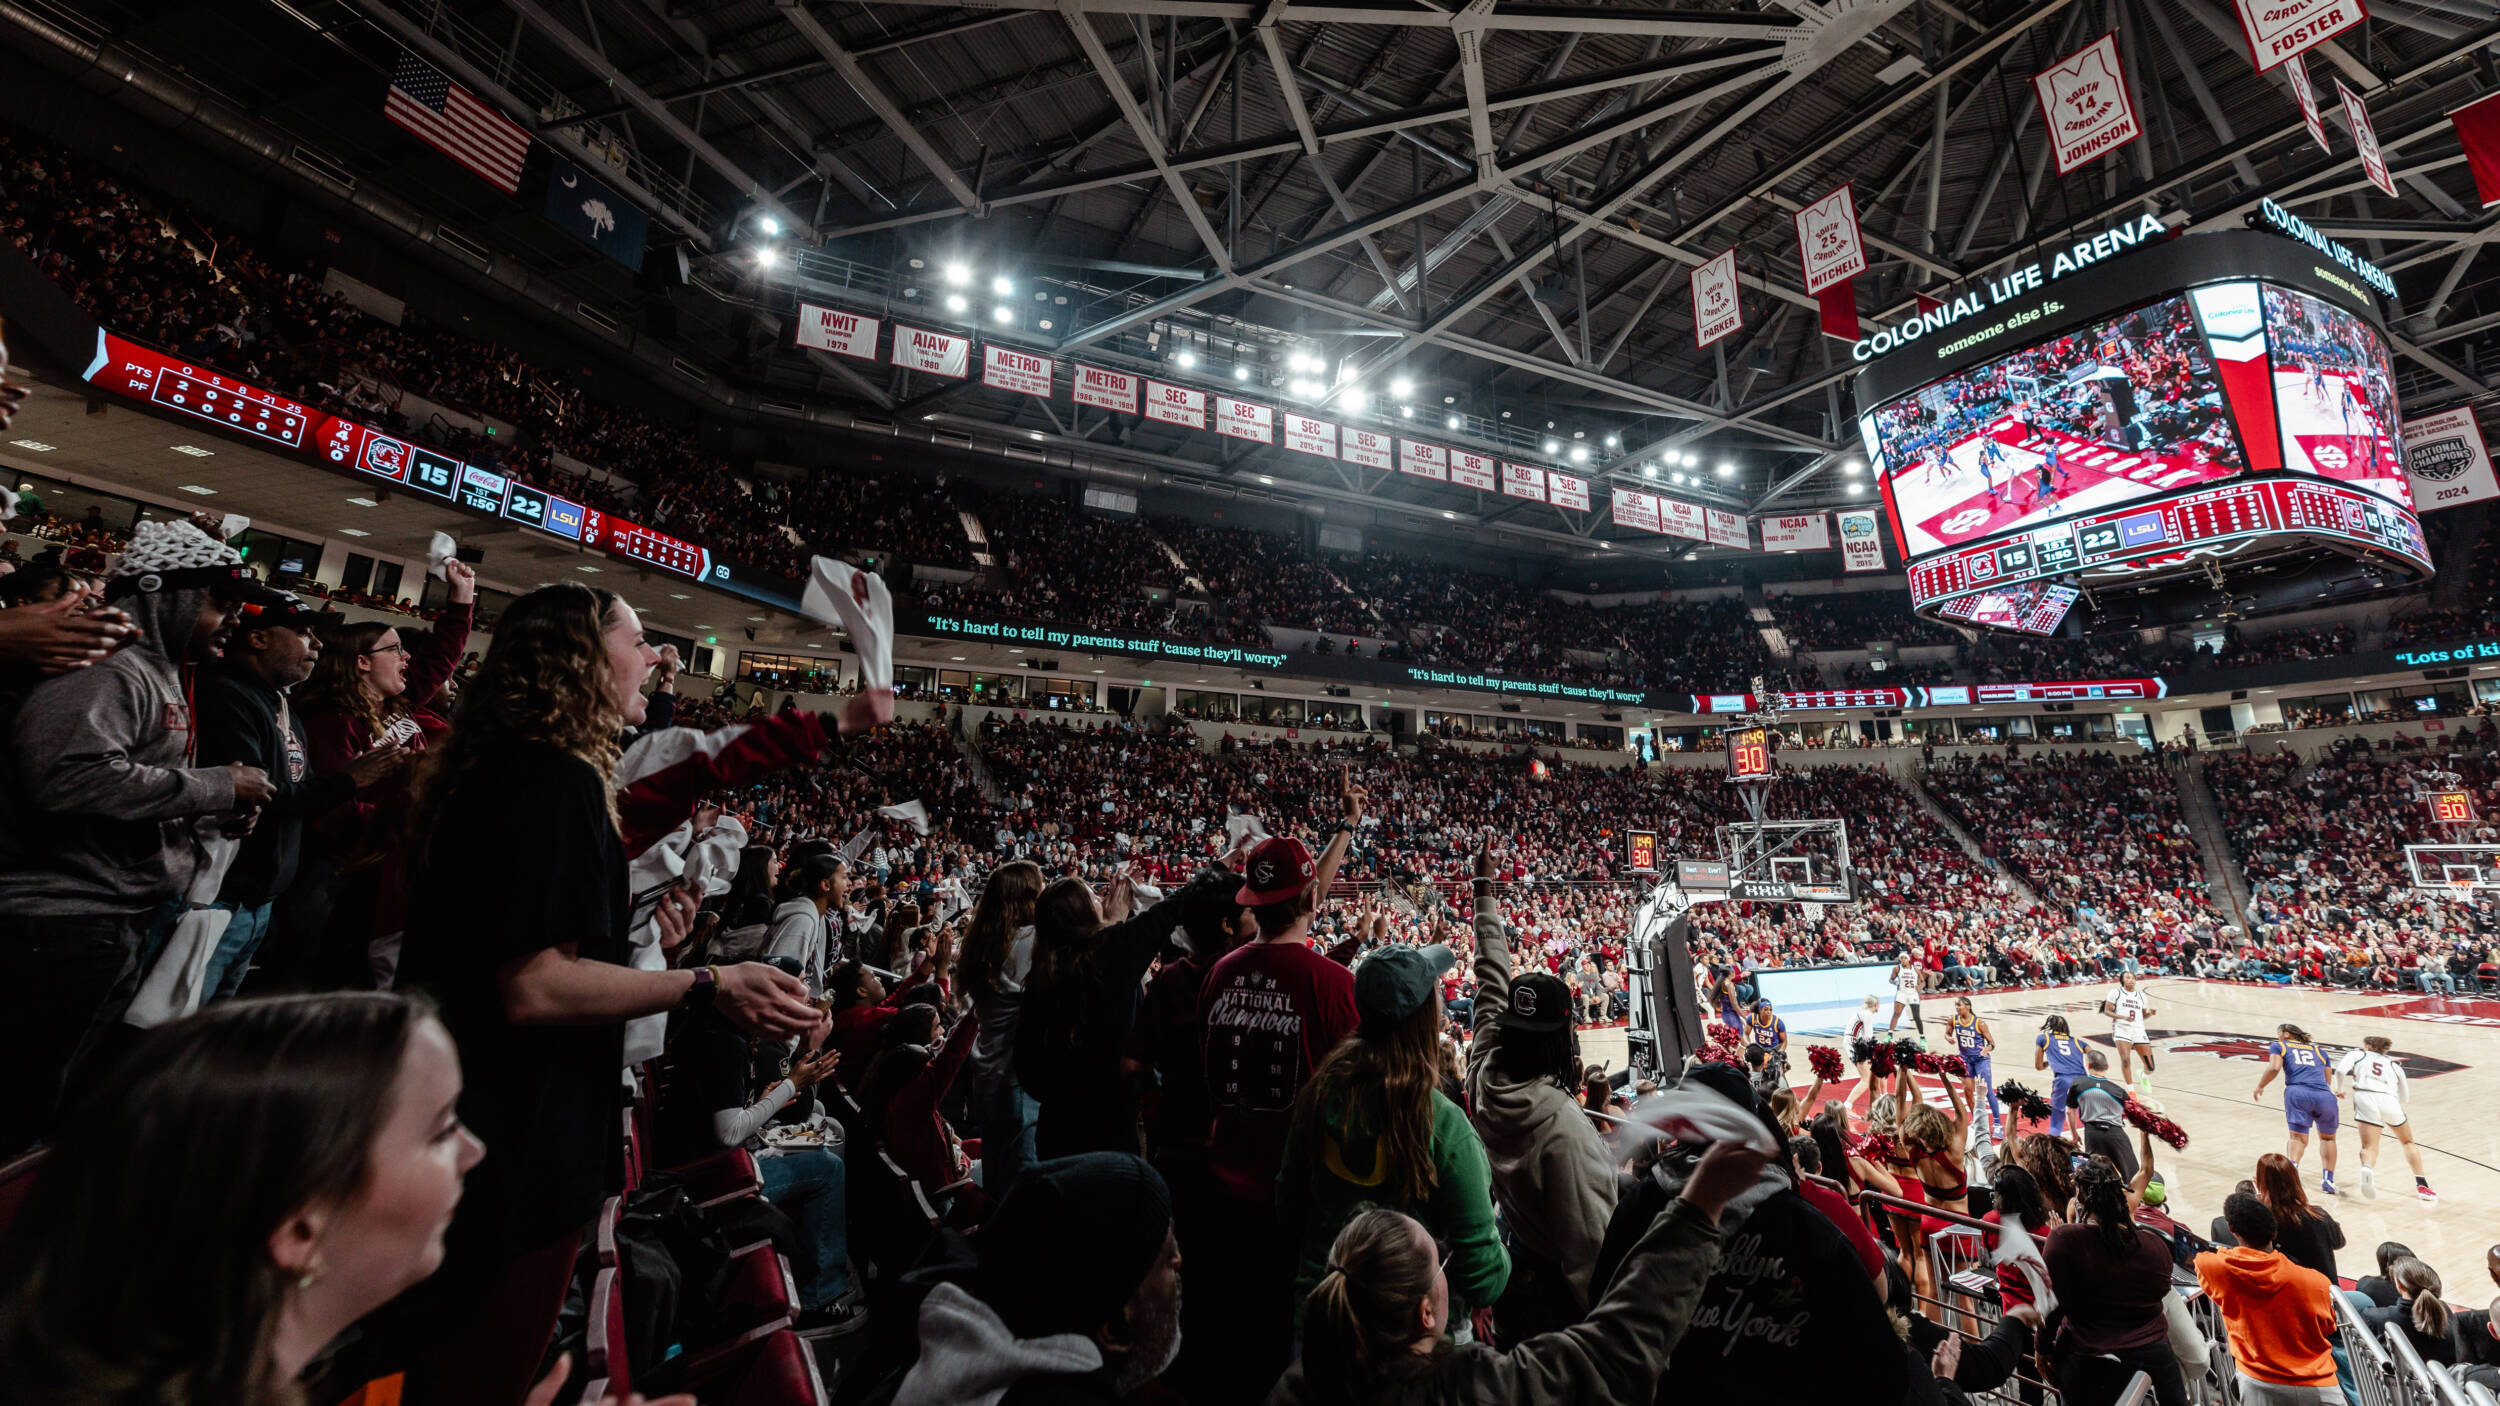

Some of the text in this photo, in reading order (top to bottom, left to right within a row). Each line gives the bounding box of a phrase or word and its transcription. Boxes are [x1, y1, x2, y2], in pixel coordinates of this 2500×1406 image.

[2271, 9, 2344, 56] FOSTER
[2065, 81, 2100, 104] SOUTH
[2075, 95, 2097, 115] 14
[2064, 100, 2113, 131] CAROLINA
[2064, 120, 2131, 164] JOHNSON
[1816, 221, 1839, 239] SOUTH
[1821, 233, 1838, 249] 25
[2262, 196, 2398, 298] COLONIAL LIFE ARENA
[1813, 239, 1848, 261] CAROLINA
[1811, 257, 1860, 288] MITCHELL
[1705, 282, 1723, 296] SOUTH
[1852, 212, 2167, 361] COLONIAL LIFE ARENA
[1710, 293, 1721, 305] 13
[1704, 298, 1730, 316] CAROLINA
[821, 311, 858, 333] NWIT
[1704, 317, 1735, 340] PARKER
[825, 328, 853, 339] CHAMPION
[1937, 300, 2065, 359] someone else is.
[826, 338, 848, 350] 1979
[913, 332, 949, 352] AIAW
[997, 352, 1041, 373] METRO
[125, 362, 152, 378] PTS
[183, 366, 193, 376] 0
[129, 379, 149, 392] PF
[176, 380, 188, 391] 2
[212, 376, 221, 385] 5
[1085, 370, 1127, 390] METRO
[206, 390, 218, 400] 0
[238, 386, 247, 395] 8
[1165, 388, 1187, 404] SEC
[173, 393, 186, 404] 0
[233, 400, 245, 410] 2
[262, 394, 275, 405] 21
[202, 403, 214, 413] 0
[260, 409, 270, 418] 2
[286, 403, 301, 414] 25
[1234, 404, 1255, 419] SEC
[229, 413, 241, 422] 0
[285, 417, 296, 427] 0
[256, 422, 267, 431] 0
[338, 420, 353, 431] TO
[1301, 420, 1320, 435] SEC
[281, 430, 293, 440] 0
[336, 430, 348, 441] 4
[1358, 433, 1376, 447] SEC
[330, 440, 350, 452] FLS
[1415, 445, 1432, 459] SEC
[2413, 441, 2463, 460] NATIONAL
[331, 450, 343, 462] 0
[1464, 456, 1481, 469] SEC
[2412, 450, 2471, 470] CHAMPIONS
[419, 462, 448, 486] 15
[1515, 468, 1531, 481] SEC
[1562, 479, 1576, 491] SEC
[475, 487, 489, 497] 1ST
[2197, 493, 2216, 501] REB
[2219, 488, 2237, 496] AST
[2436, 486, 2469, 500] 2024
[466, 495, 496, 512] 1:50
[1628, 493, 1643, 505] SEC
[511, 495, 542, 518] 22
[1672, 504, 1691, 516] NCAA
[552, 509, 578, 526] LSU
[590, 510, 600, 518] TO
[1717, 513, 1736, 526] NCAA
[2366, 512, 2379, 527] 15
[589, 518, 598, 527] 4
[1780, 518, 1808, 529] NCAA
[585, 527, 598, 536] FLS
[613, 530, 627, 540] PTS
[2128, 522, 2157, 537] LSU
[586, 534, 595, 543] 0
[615, 541, 625, 549] PF
[2043, 539, 2067, 550] 1ST
[2083, 530, 2116, 549] 22
[1846, 541, 1877, 553] NCAA
[2003, 551, 2027, 567] 15
[2044, 550, 2072, 562] 1:50
[2014, 570, 2027, 579] FLS
[963, 620, 999, 637] hard
[1003, 625, 1018, 638] to
[1021, 625, 1044, 641] tell
[1047, 632, 1069, 647] my
[1072, 633, 1124, 650] parents
[1128, 637, 1159, 653] stuff
[1203, 645, 1241, 664] they’ll
[2395, 642, 2500, 665] “Lots of ki
[1431, 671, 1454, 683] hard
[1456, 675, 1467, 684] to
[1468, 674, 1484, 686] tell
[1485, 679, 1500, 690] my
[1502, 680, 1537, 692] parents
[1538, 683, 1560, 694] stuff
[1741, 730, 1765, 746] 1:49
[1736, 746, 1765, 773] 30
[2442, 794, 2466, 803] 1:49
[2439, 803, 2467, 819] 30
[1636, 836, 1652, 848] 1:49
[1634, 850, 1650, 866] 30
[1234, 976, 1245, 986] 20
[1265, 979, 1277, 989] 24
[1904, 980, 1914, 988] 25
[1222, 992, 1294, 1012] NATIONAL
[1207, 998, 1302, 1036] Champions
[1756, 1029, 1773, 1037] LSU
[1956, 1028, 1975, 1038] LSU
[1758, 1036, 1772, 1045] 24
[1960, 1036, 1975, 1047] 50
[2057, 1040, 2071, 1055] 5
[2292, 1049, 2315, 1066] 12
[2371, 1062, 2383, 1076] 5
[1722, 1286, 1811, 1357] York
